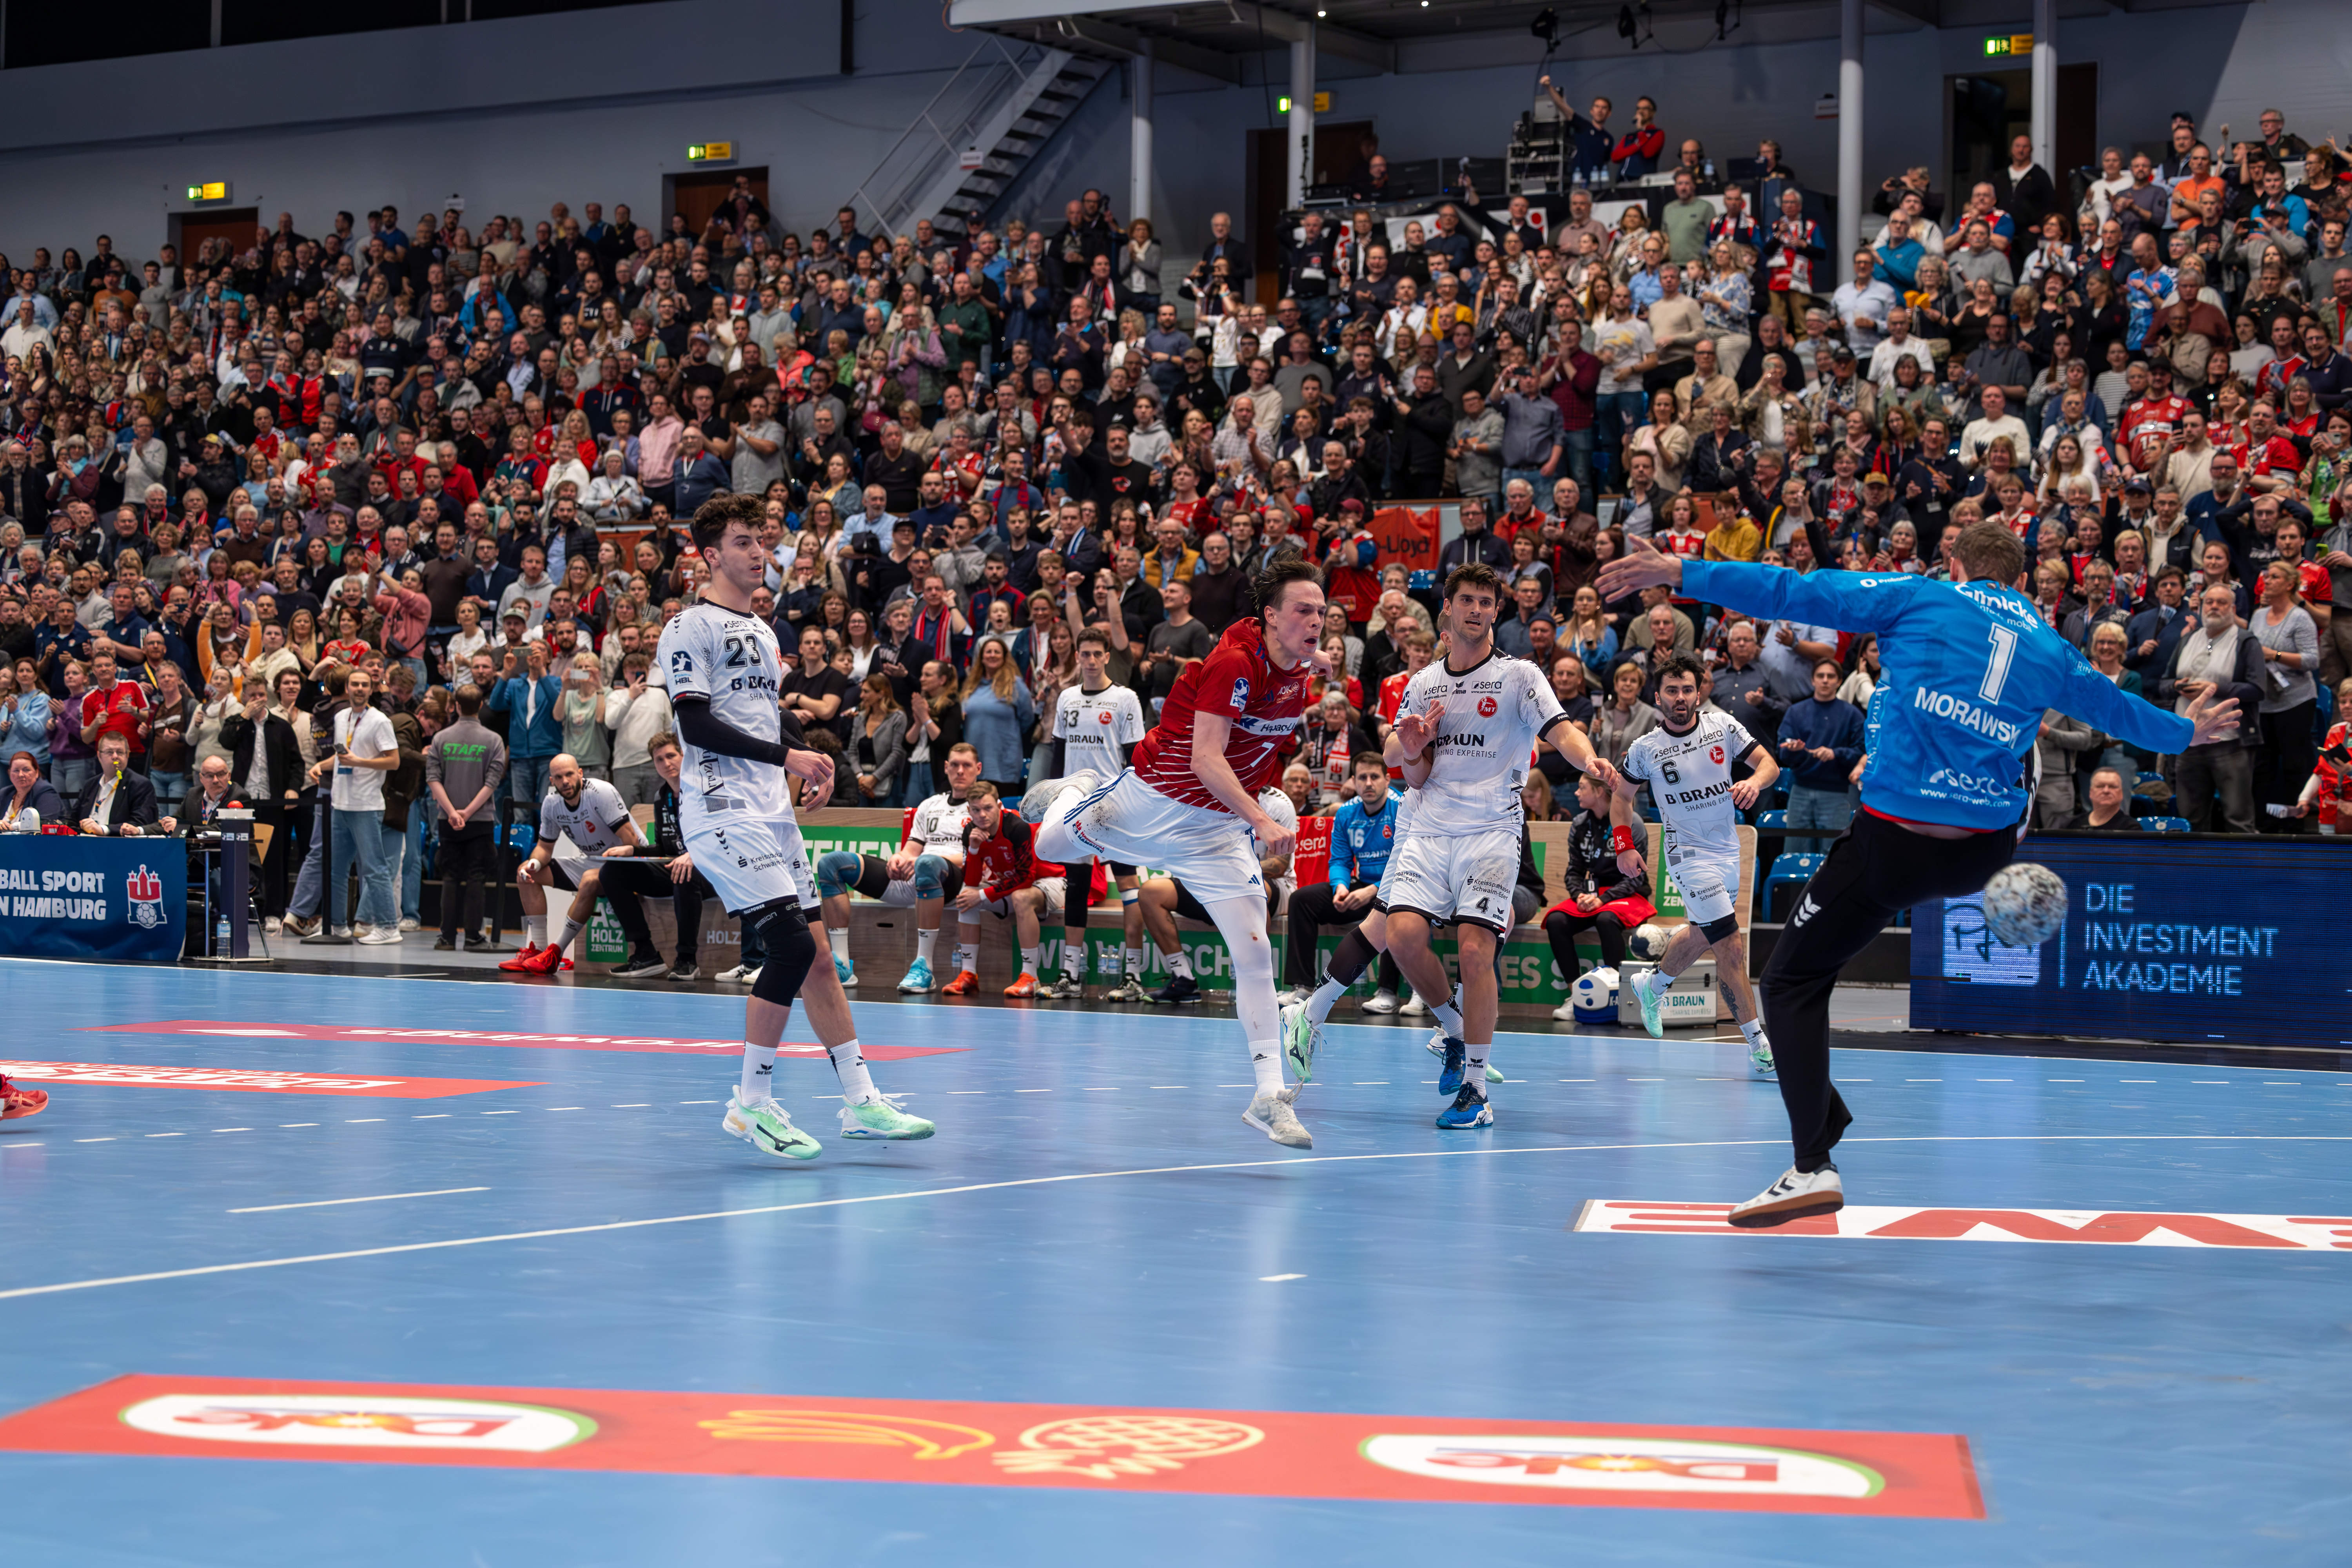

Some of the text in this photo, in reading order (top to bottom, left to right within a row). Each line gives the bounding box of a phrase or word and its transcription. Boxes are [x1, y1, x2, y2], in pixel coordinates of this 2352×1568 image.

[724, 634, 762, 669] 23
[1978, 622, 2018, 706] 1
[1428, 685, 1448, 695] sera
[1479, 681, 1502, 690] sera
[1069, 734, 1104, 744] BRAUN
[1703, 730, 1723, 742] sera
[443, 743, 487, 756] STAFF
[1250, 742, 1275, 768] 7
[1457, 749, 1497, 758] EXPERTISE
[1658, 745, 1680, 757] sera
[1682, 746, 1697, 755] erima
[1660, 759, 1681, 786] 6
[1664, 779, 1731, 804] B BRAUN
[1685, 800, 1717, 812] SHARING
[1347, 828, 1365, 848] 16
[0, 869, 105, 893] BALL SPORT
[1474, 878, 1511, 895] Kreissparkasse
[1471, 885, 1508, 901] Schwalm-Eder
[2086, 883, 2135, 914] DIE
[13, 896, 107, 921] HAMBURG
[1475, 896, 1490, 914] 4
[1492, 913, 1505, 922] erima
[591, 929, 623, 943] HOLZ
[707, 930, 742, 945] HOLZ
[2085, 922, 2279, 957] INVESTMENT
[591, 944, 623, 953] ZENTRUM
[2083, 960, 2243, 996] AKADEMIE
[1673, 996, 1705, 1007] BRAUN
[1605, 1201, 2352, 1250] WE
